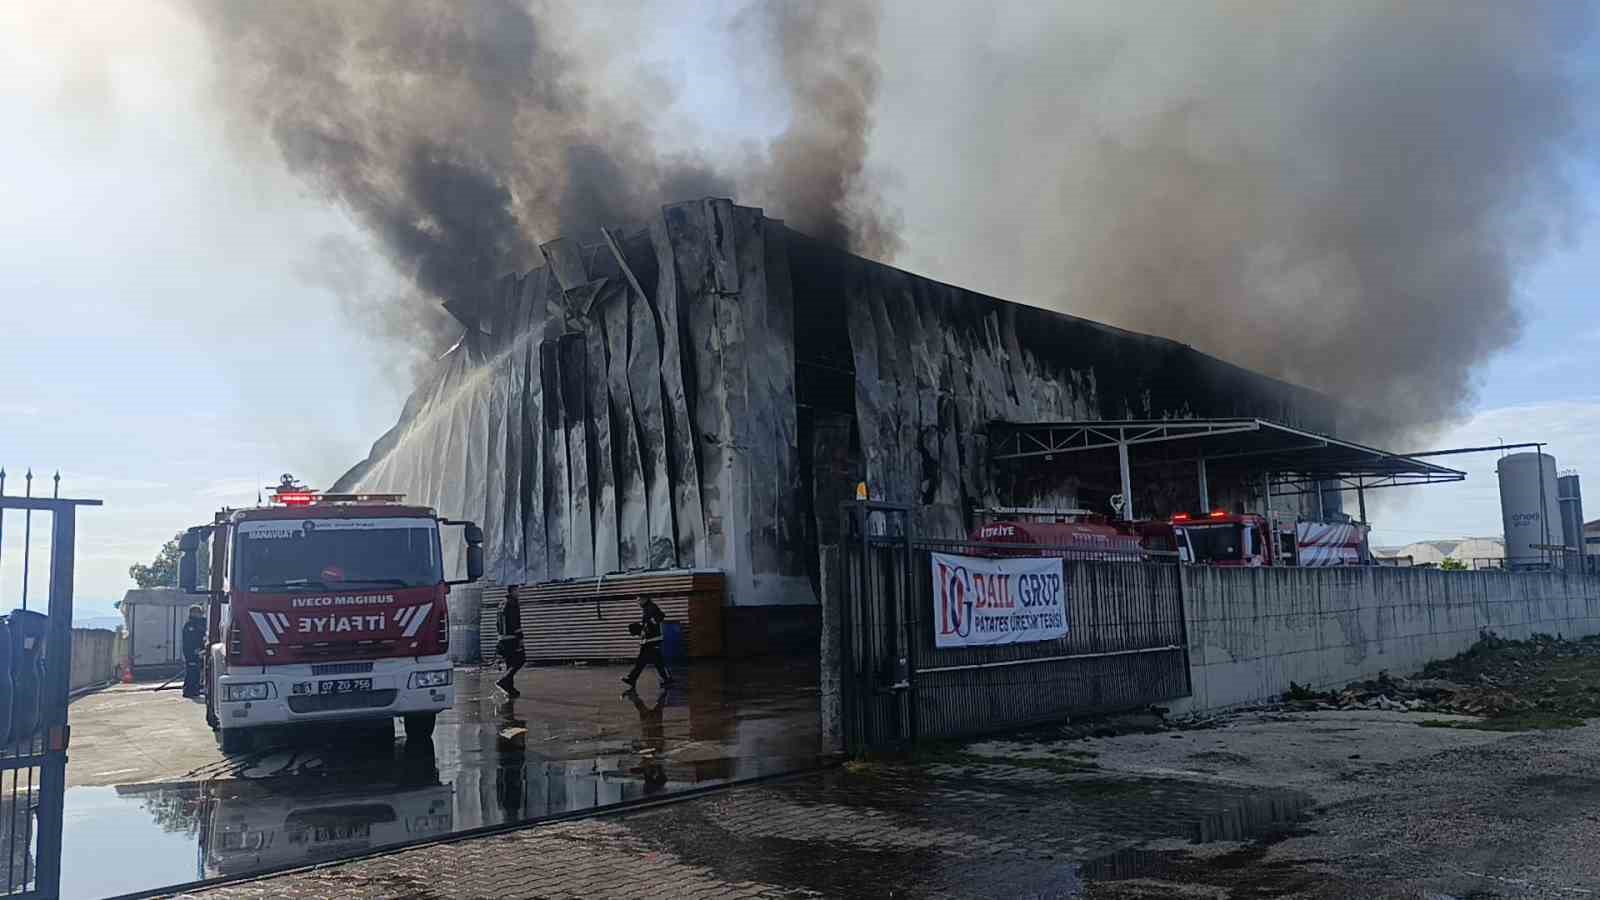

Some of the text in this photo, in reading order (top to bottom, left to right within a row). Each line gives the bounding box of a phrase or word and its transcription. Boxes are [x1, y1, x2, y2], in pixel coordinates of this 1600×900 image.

[1018, 573, 1060, 607] GRUP
[292, 594, 394, 608] IVECO MAGIRUS
[974, 615, 1009, 633] PATATES
